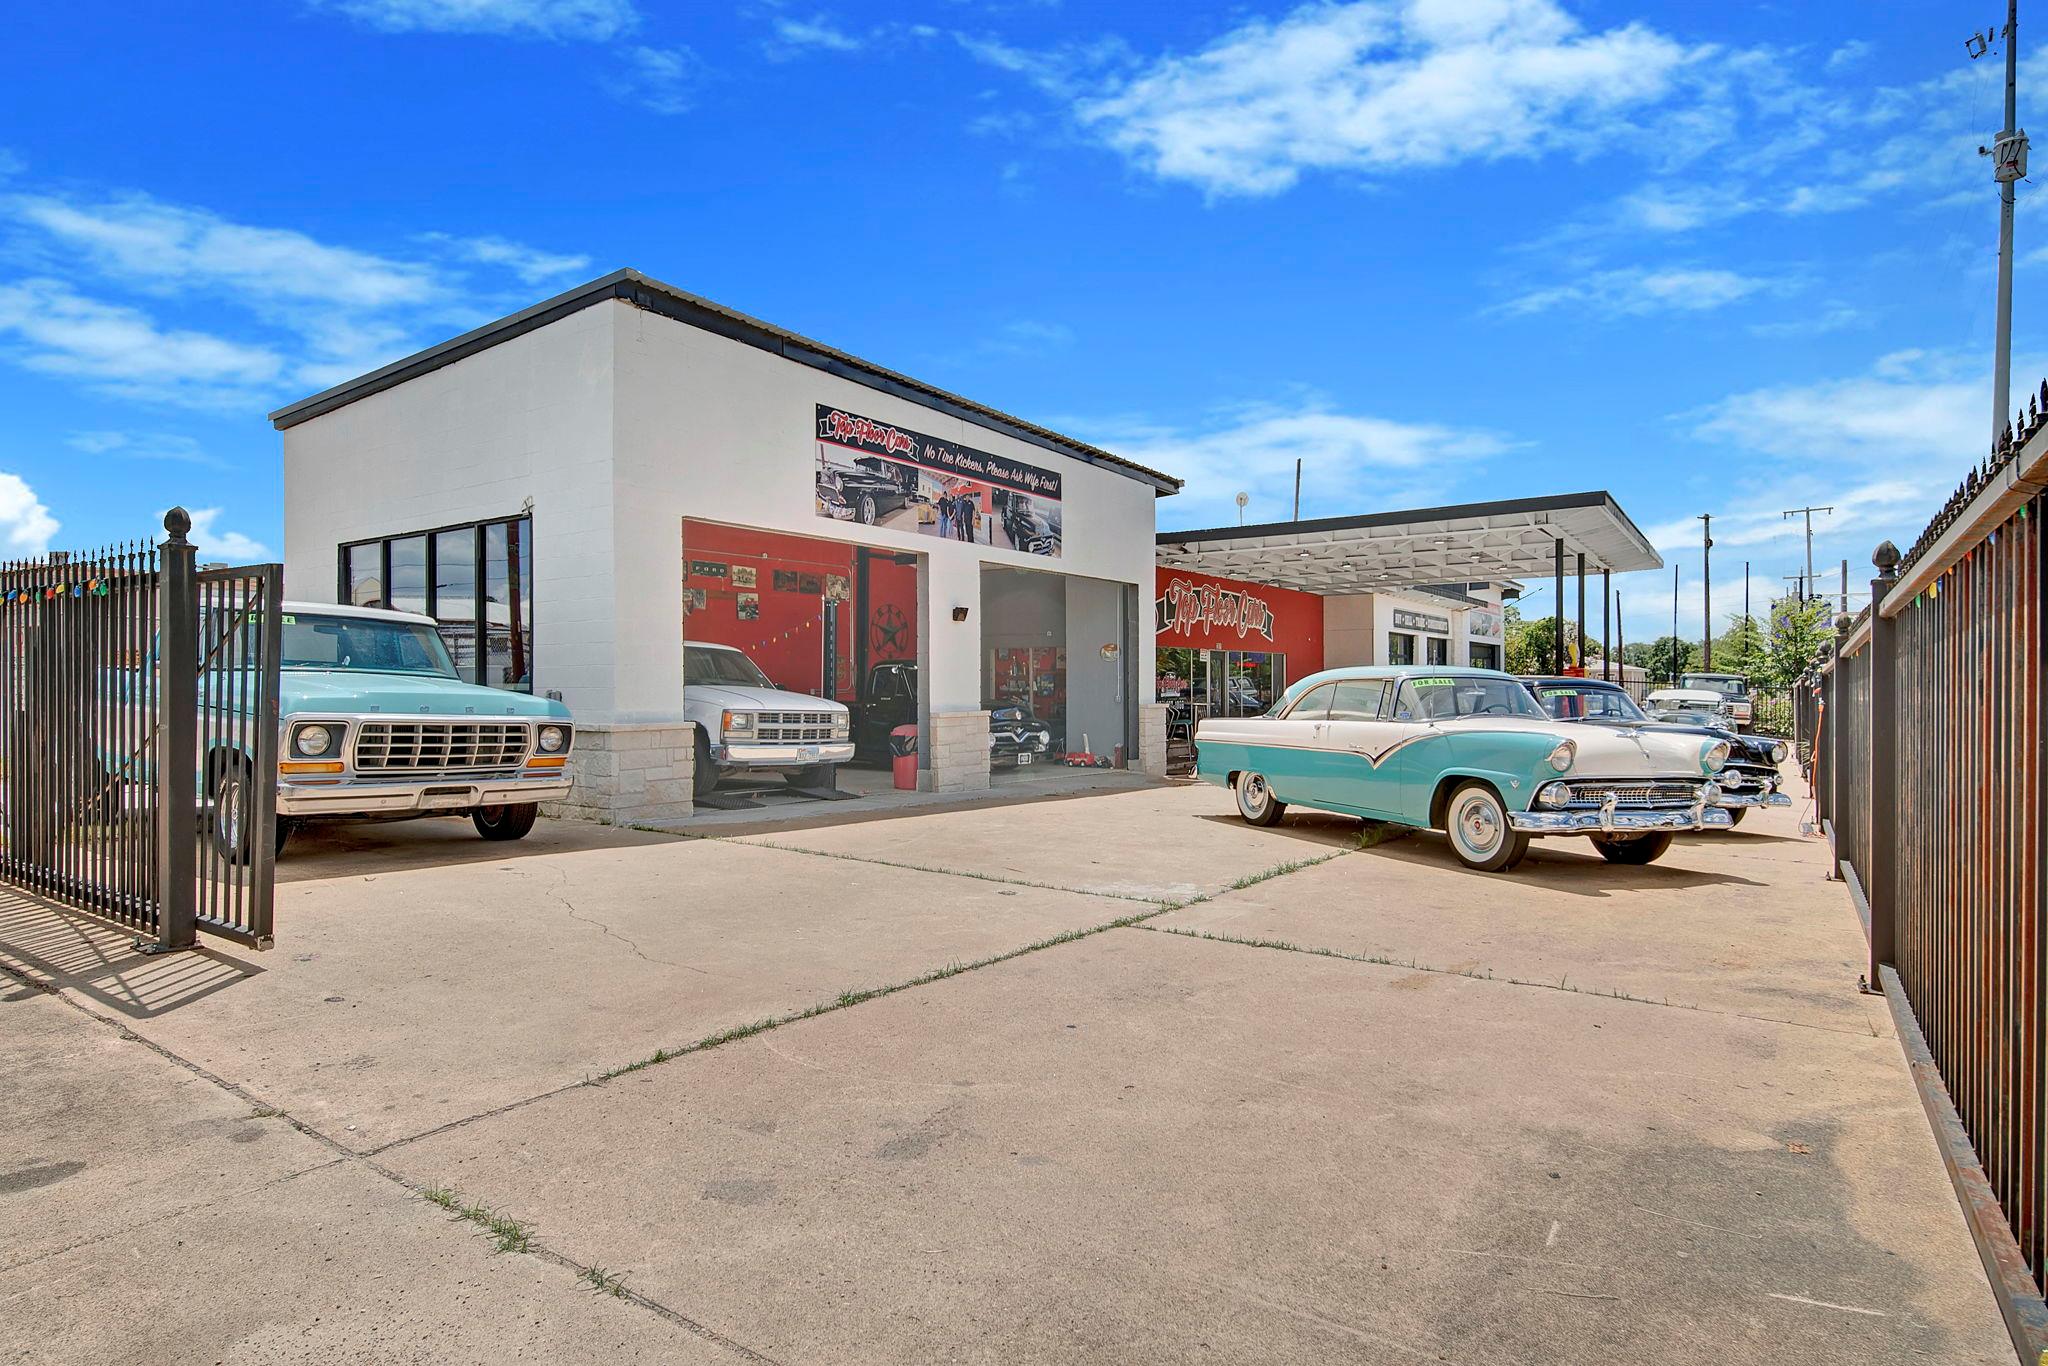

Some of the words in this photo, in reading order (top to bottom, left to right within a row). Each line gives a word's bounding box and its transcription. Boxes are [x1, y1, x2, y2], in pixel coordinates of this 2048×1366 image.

[830, 410, 855, 443] Top
[855, 418, 886, 446] Floor
[886, 427, 912, 454] Cars
[924, 444, 935, 459] No
[937, 447, 954, 464] Tire
[954, 453, 984, 473] Kickers,
[986, 461, 1010, 479] Please
[1010, 468, 1024, 483] Ask
[1024, 472, 1039, 491] Wife
[1039, 476, 1058, 491] First!
[695, 565, 725, 574] FORD
[1169, 578, 1200, 637] Top
[1200, 583, 1237, 636] Floor
[1236, 590, 1265, 639] Cars
[1412, 679, 1430, 687] FOR
